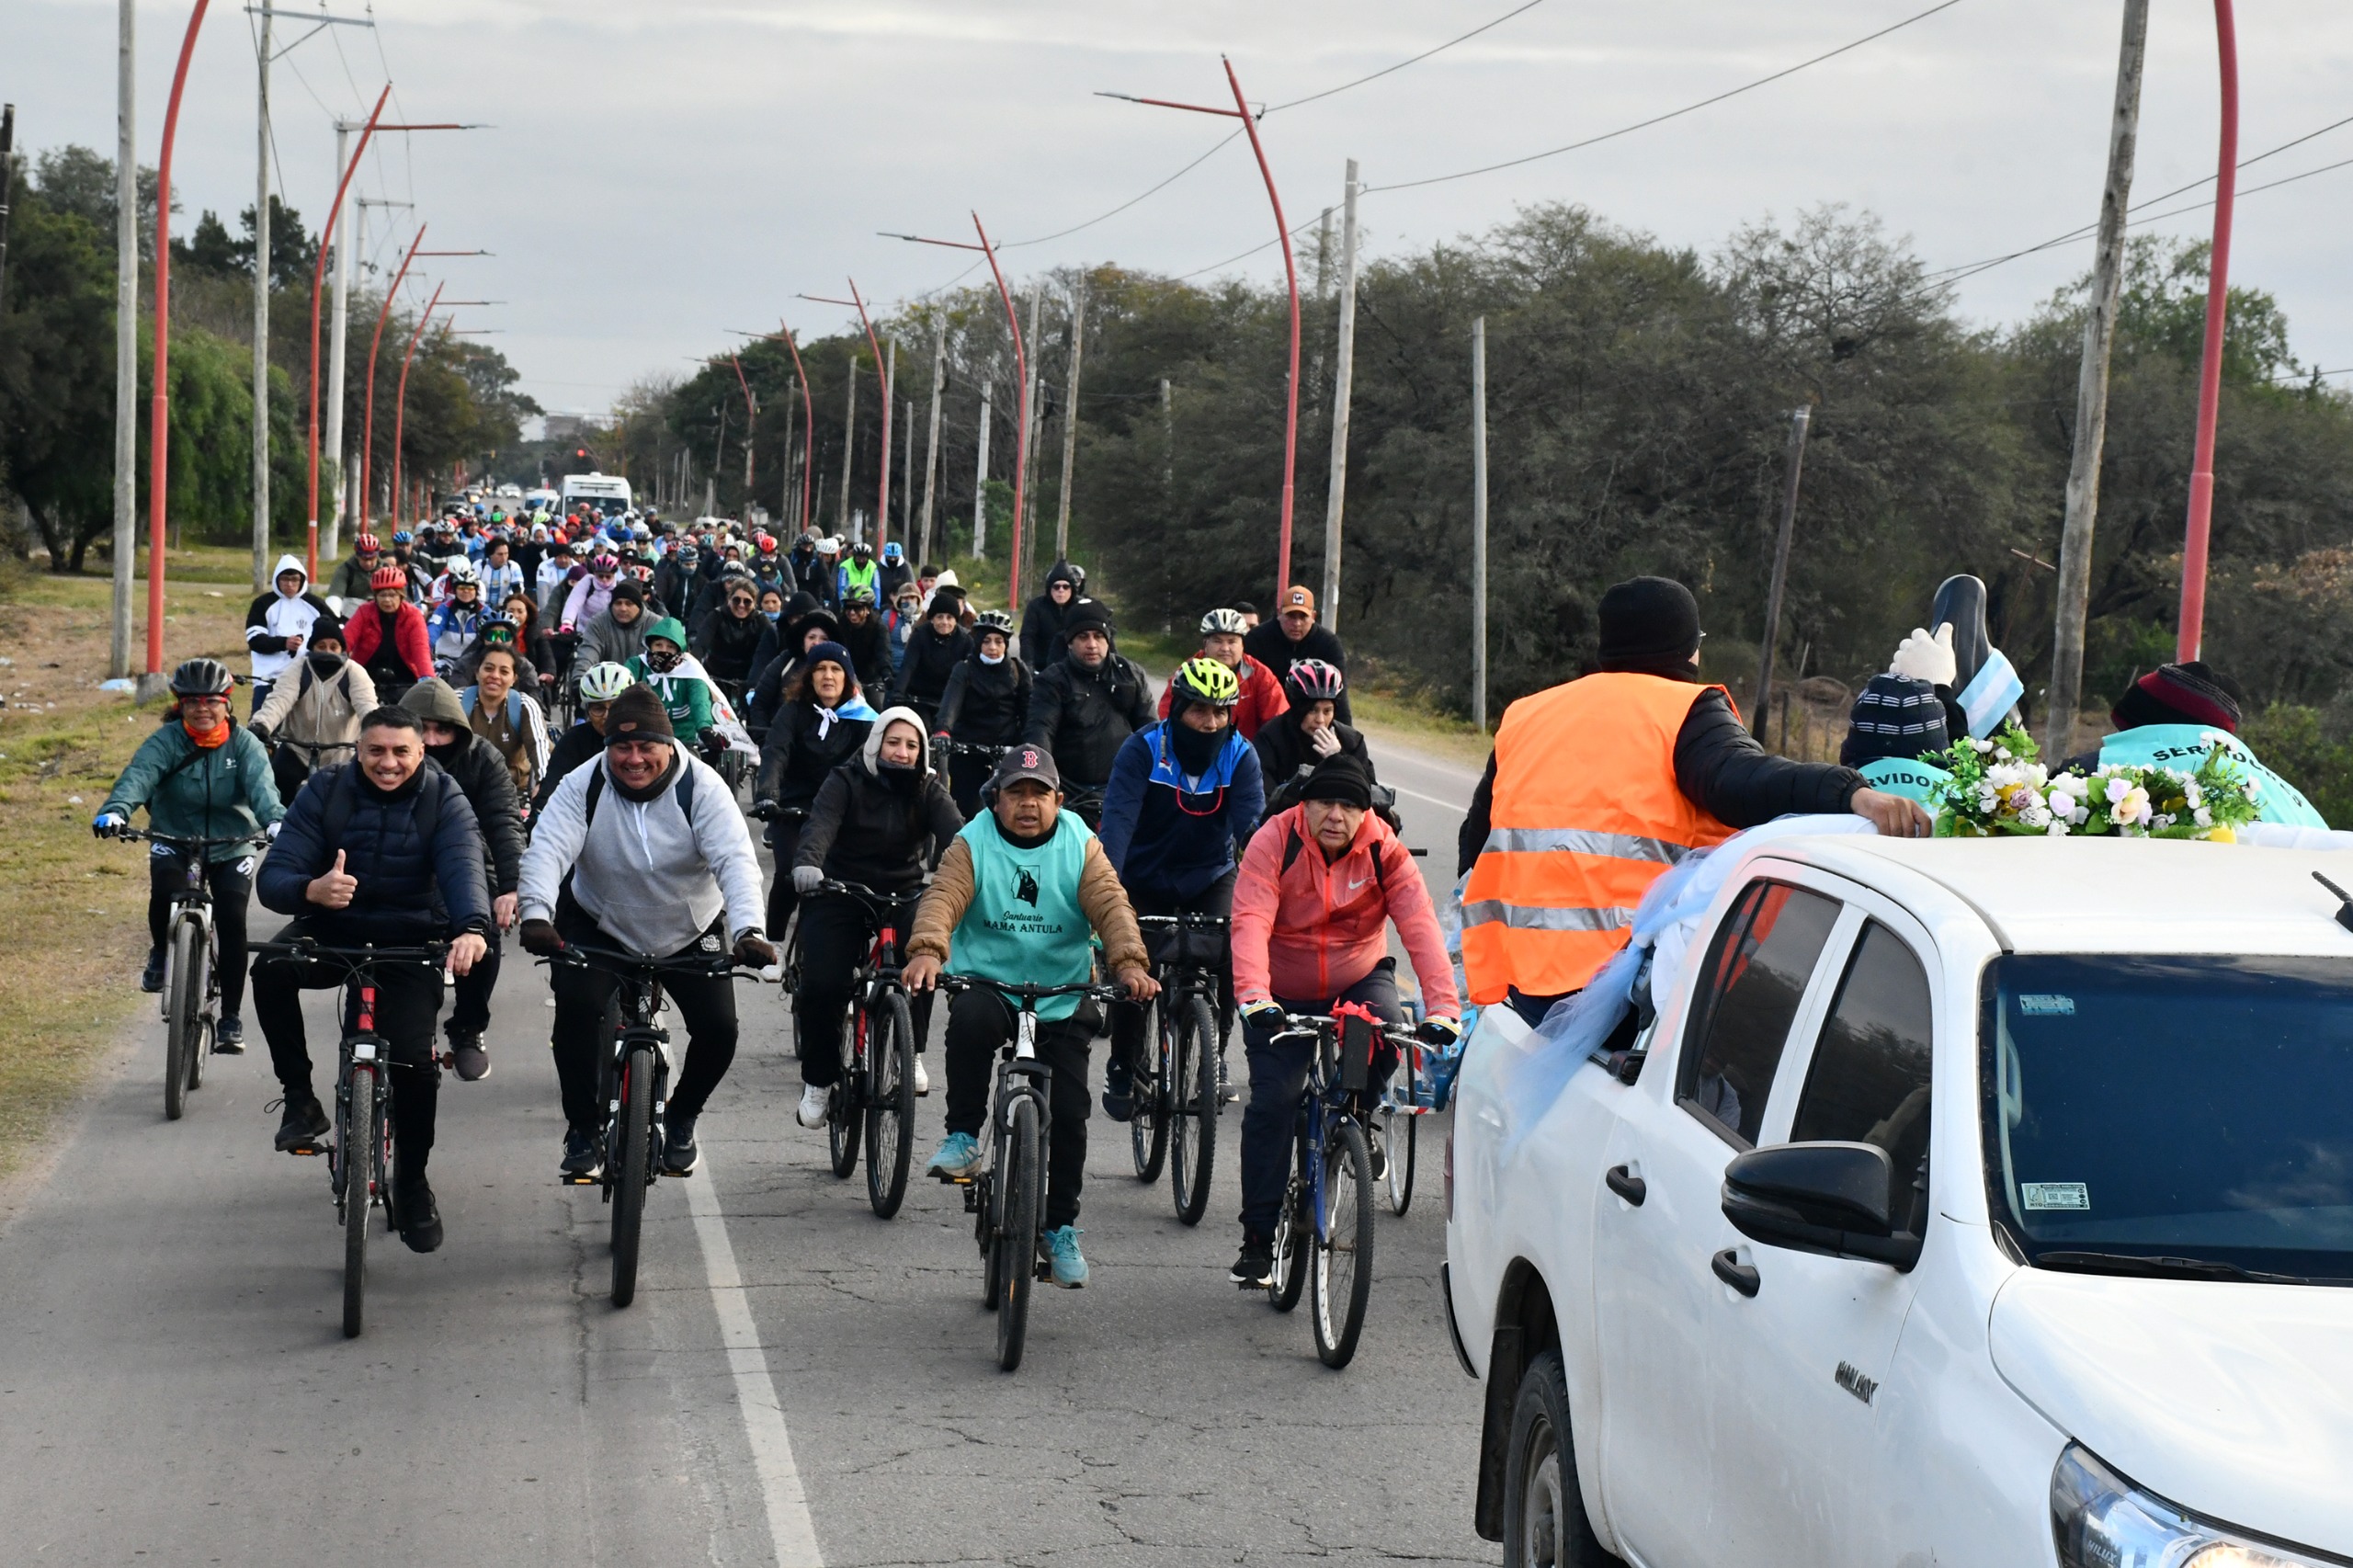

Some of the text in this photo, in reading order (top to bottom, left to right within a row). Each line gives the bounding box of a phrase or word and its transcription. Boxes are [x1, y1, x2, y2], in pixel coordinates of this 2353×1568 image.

[1022, 751, 1038, 768] B
[1003, 911, 1044, 922] Santuario
[983, 920, 1063, 934] MAMA ANTULA
[2087, 1540, 2117, 1563] HILUX
